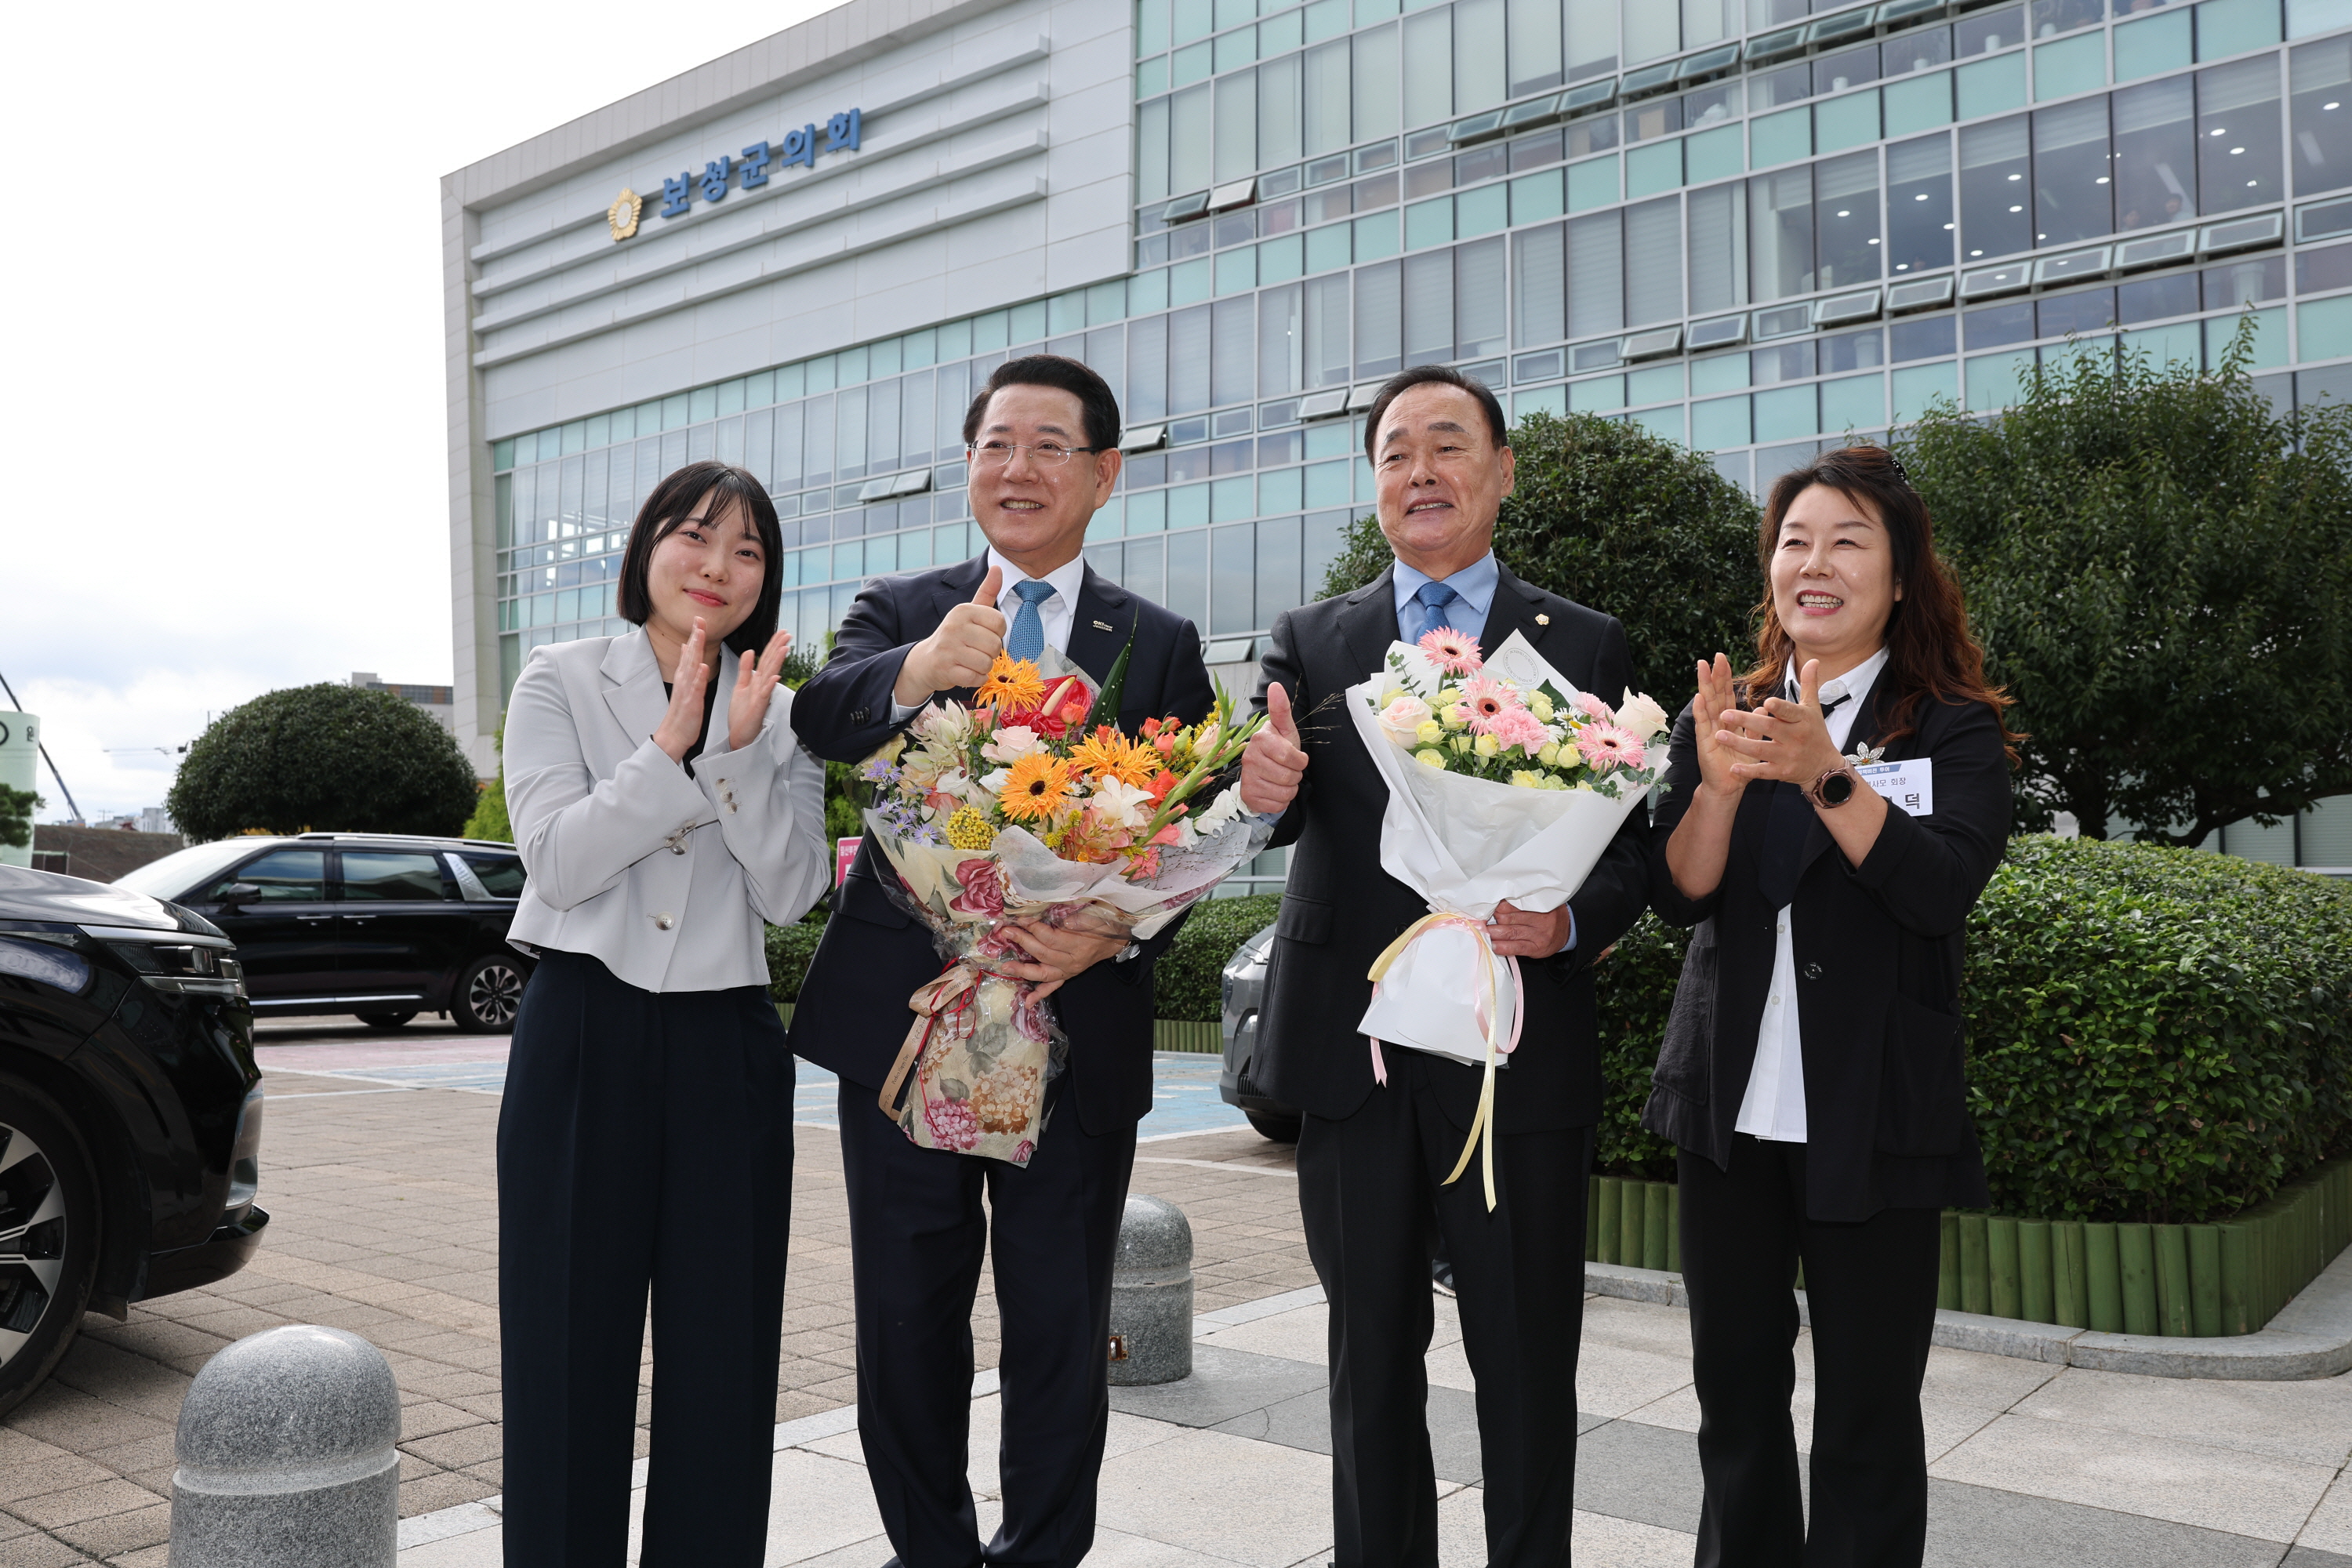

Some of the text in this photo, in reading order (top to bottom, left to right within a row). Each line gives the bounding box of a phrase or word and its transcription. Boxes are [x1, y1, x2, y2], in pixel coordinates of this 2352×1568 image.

[661, 108, 861, 218] 보성군의회
[1905, 793, 1920, 809] 덕
[948, 982, 960, 993] Happy
[898, 1062, 907, 1073] Happy
